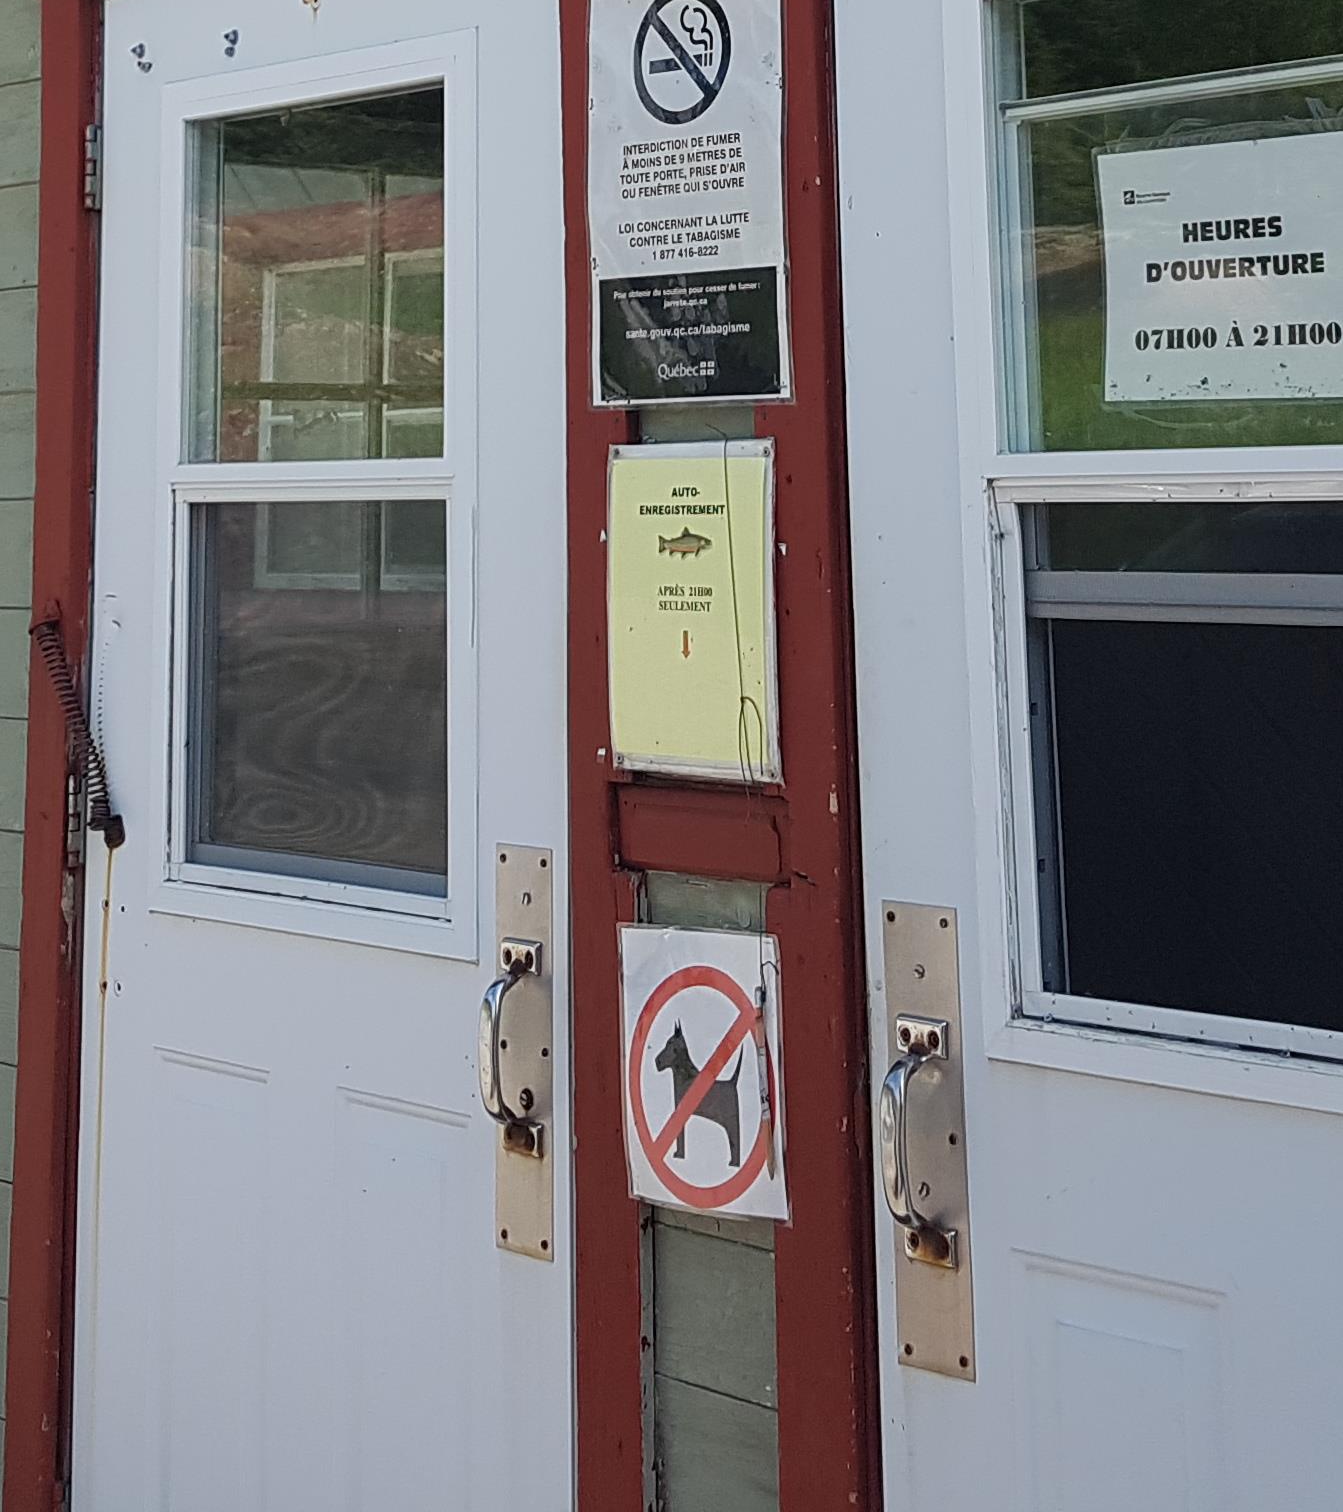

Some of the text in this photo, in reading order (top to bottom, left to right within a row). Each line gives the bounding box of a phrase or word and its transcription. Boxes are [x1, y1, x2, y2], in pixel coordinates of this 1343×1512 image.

[623, 132, 741, 156] INTERDICTION DE FUMER
[622, 158, 629, 171] À
[631, 156, 662, 169] MOINS
[664, 154, 677, 166] DE
[679, 154, 685, 164] 9
[728, 147, 743, 158] DE
[620, 162, 746, 185] TOUTE PORTE, PRISE D'AIR
[621, 188, 636, 199] OU
[683, 182, 701, 193] QUI
[702, 177, 745, 191] S'OUVRE
[618, 212, 750, 234] LOI CONCERNANT LA LUTTE
[1182, 215, 1284, 244] HEURES
[629, 227, 741, 248] CONTRE LE TABAGISME
[652, 251, 657, 260] 1
[659, 249, 675, 260] 877
[1145, 251, 1326, 283] D'OUVERTURE
[705, 284, 727, 293] cesser
[1134, 320, 1343, 351] 07H00 À 21H00
[657, 362, 699, 380] Québec
[671, 487, 701, 498] AUTO-
[639, 504, 726, 516] ENREGISTREMENT
[657, 583, 713, 597] APRÈS 21H00
[658, 600, 713, 613] SEULEMENT
